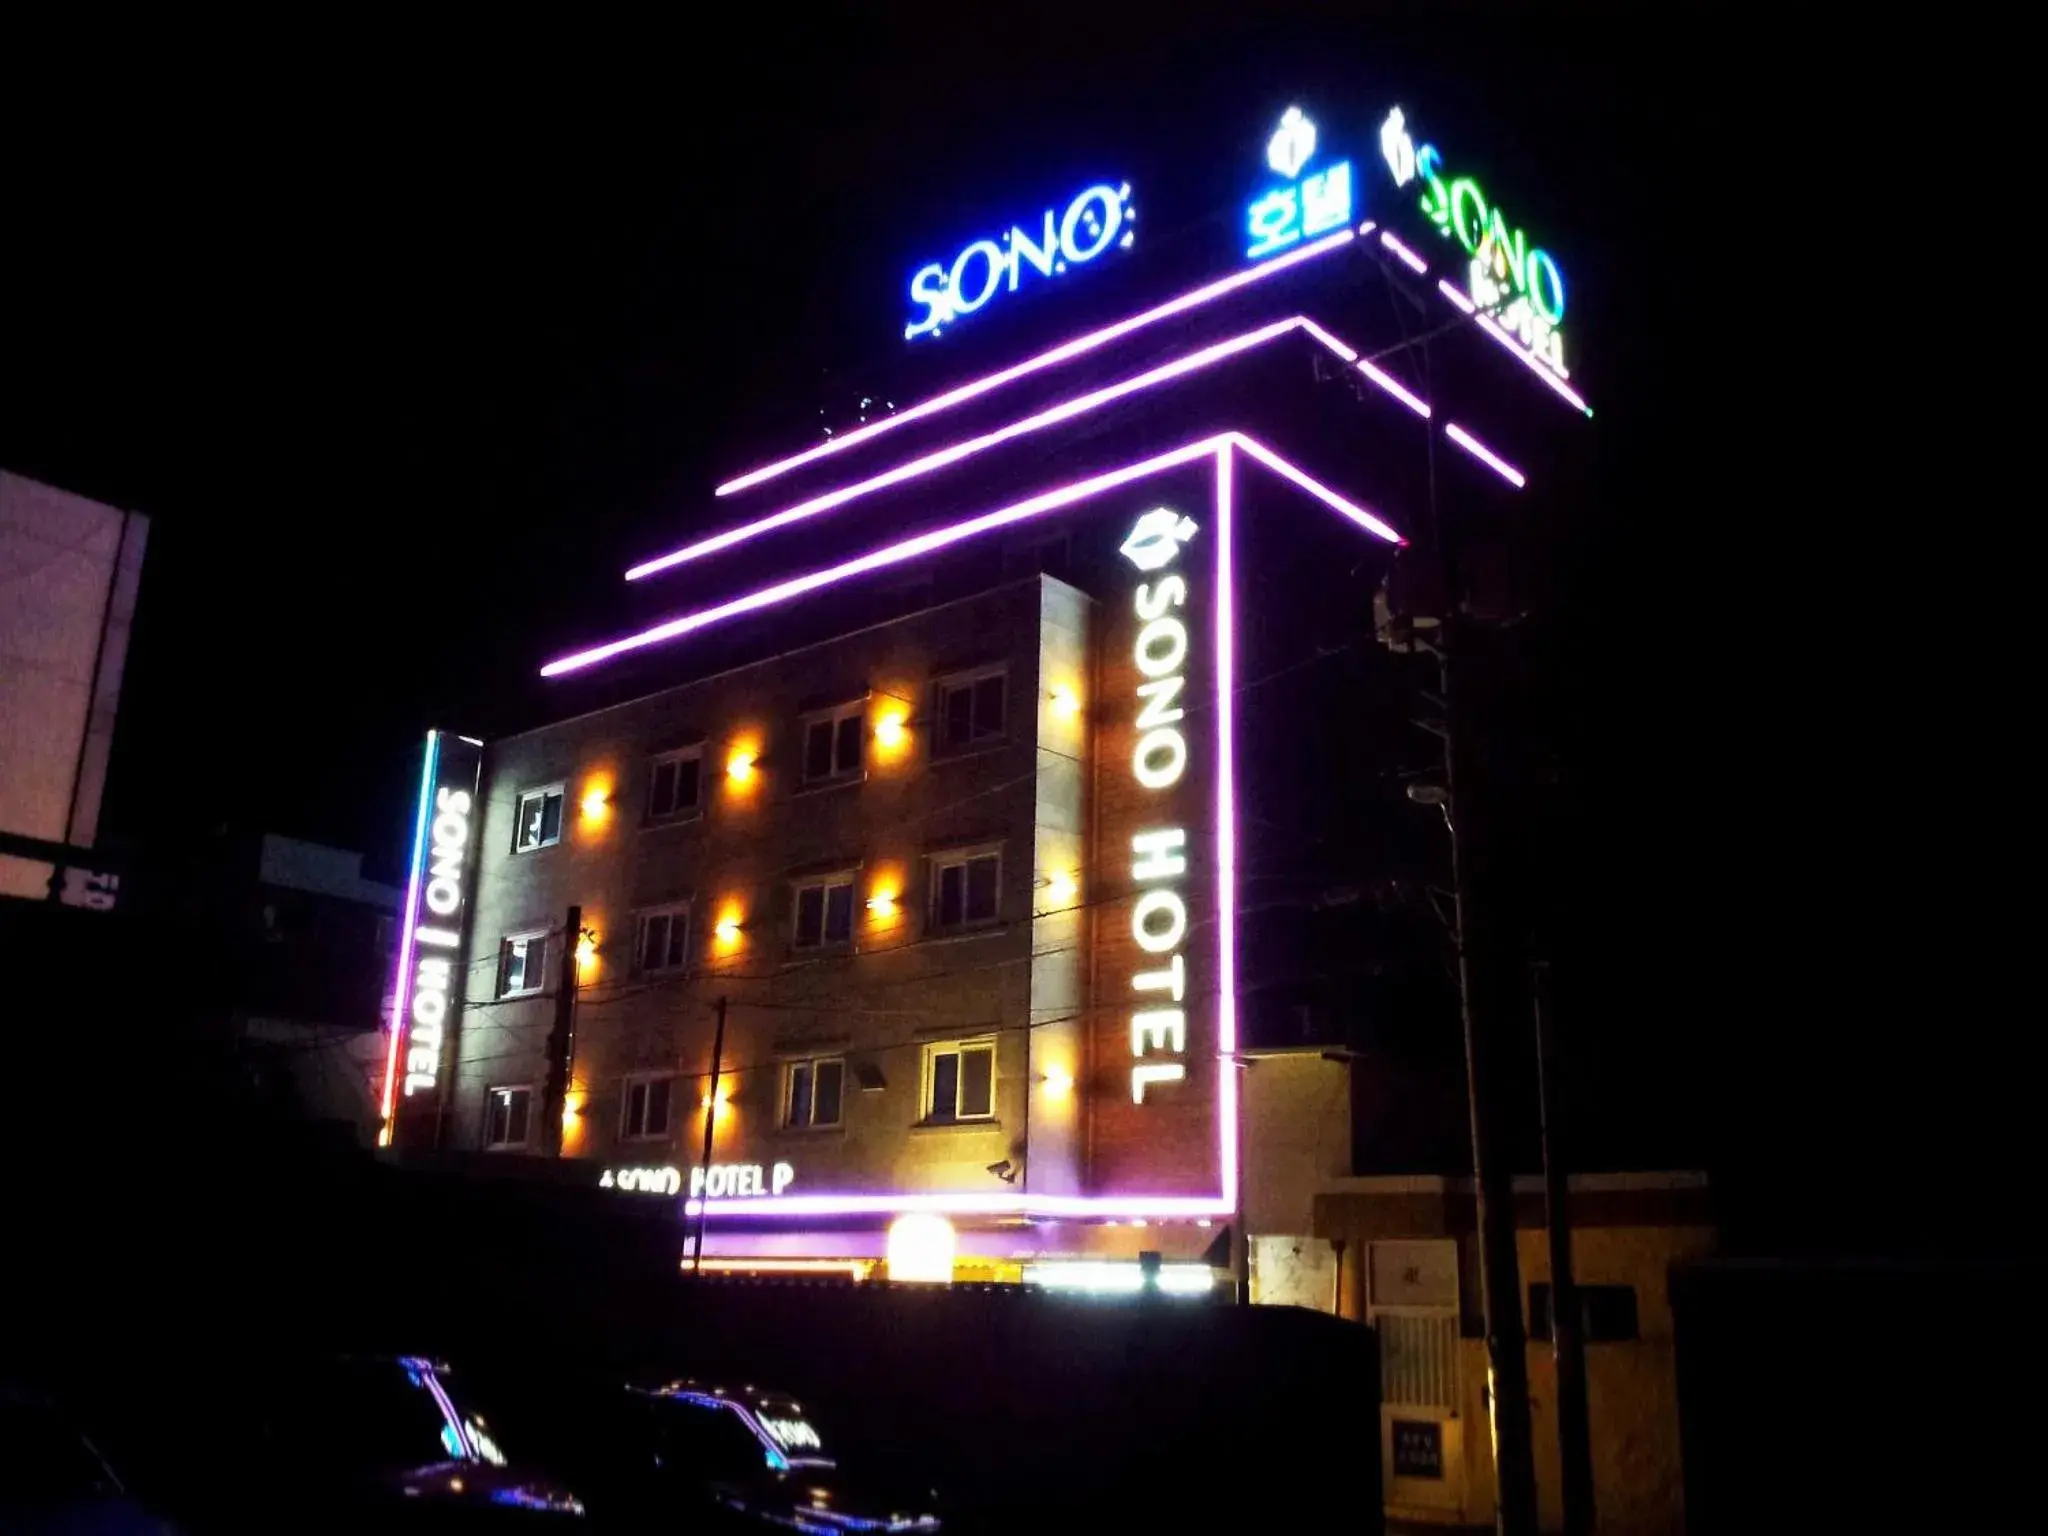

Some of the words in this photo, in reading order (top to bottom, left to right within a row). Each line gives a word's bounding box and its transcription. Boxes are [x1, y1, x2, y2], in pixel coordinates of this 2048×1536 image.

[904, 184, 1128, 340] SONO
[1247, 160, 1352, 258] 호텔
[1415, 143, 1566, 326] SONO
[1132, 574, 1188, 790] SONO
[426, 787, 471, 915] SONO
[405, 957, 451, 1097] HOTEL
[1130, 827, 1187, 1106] HOTEL
[772, 1161, 795, 1195] P
